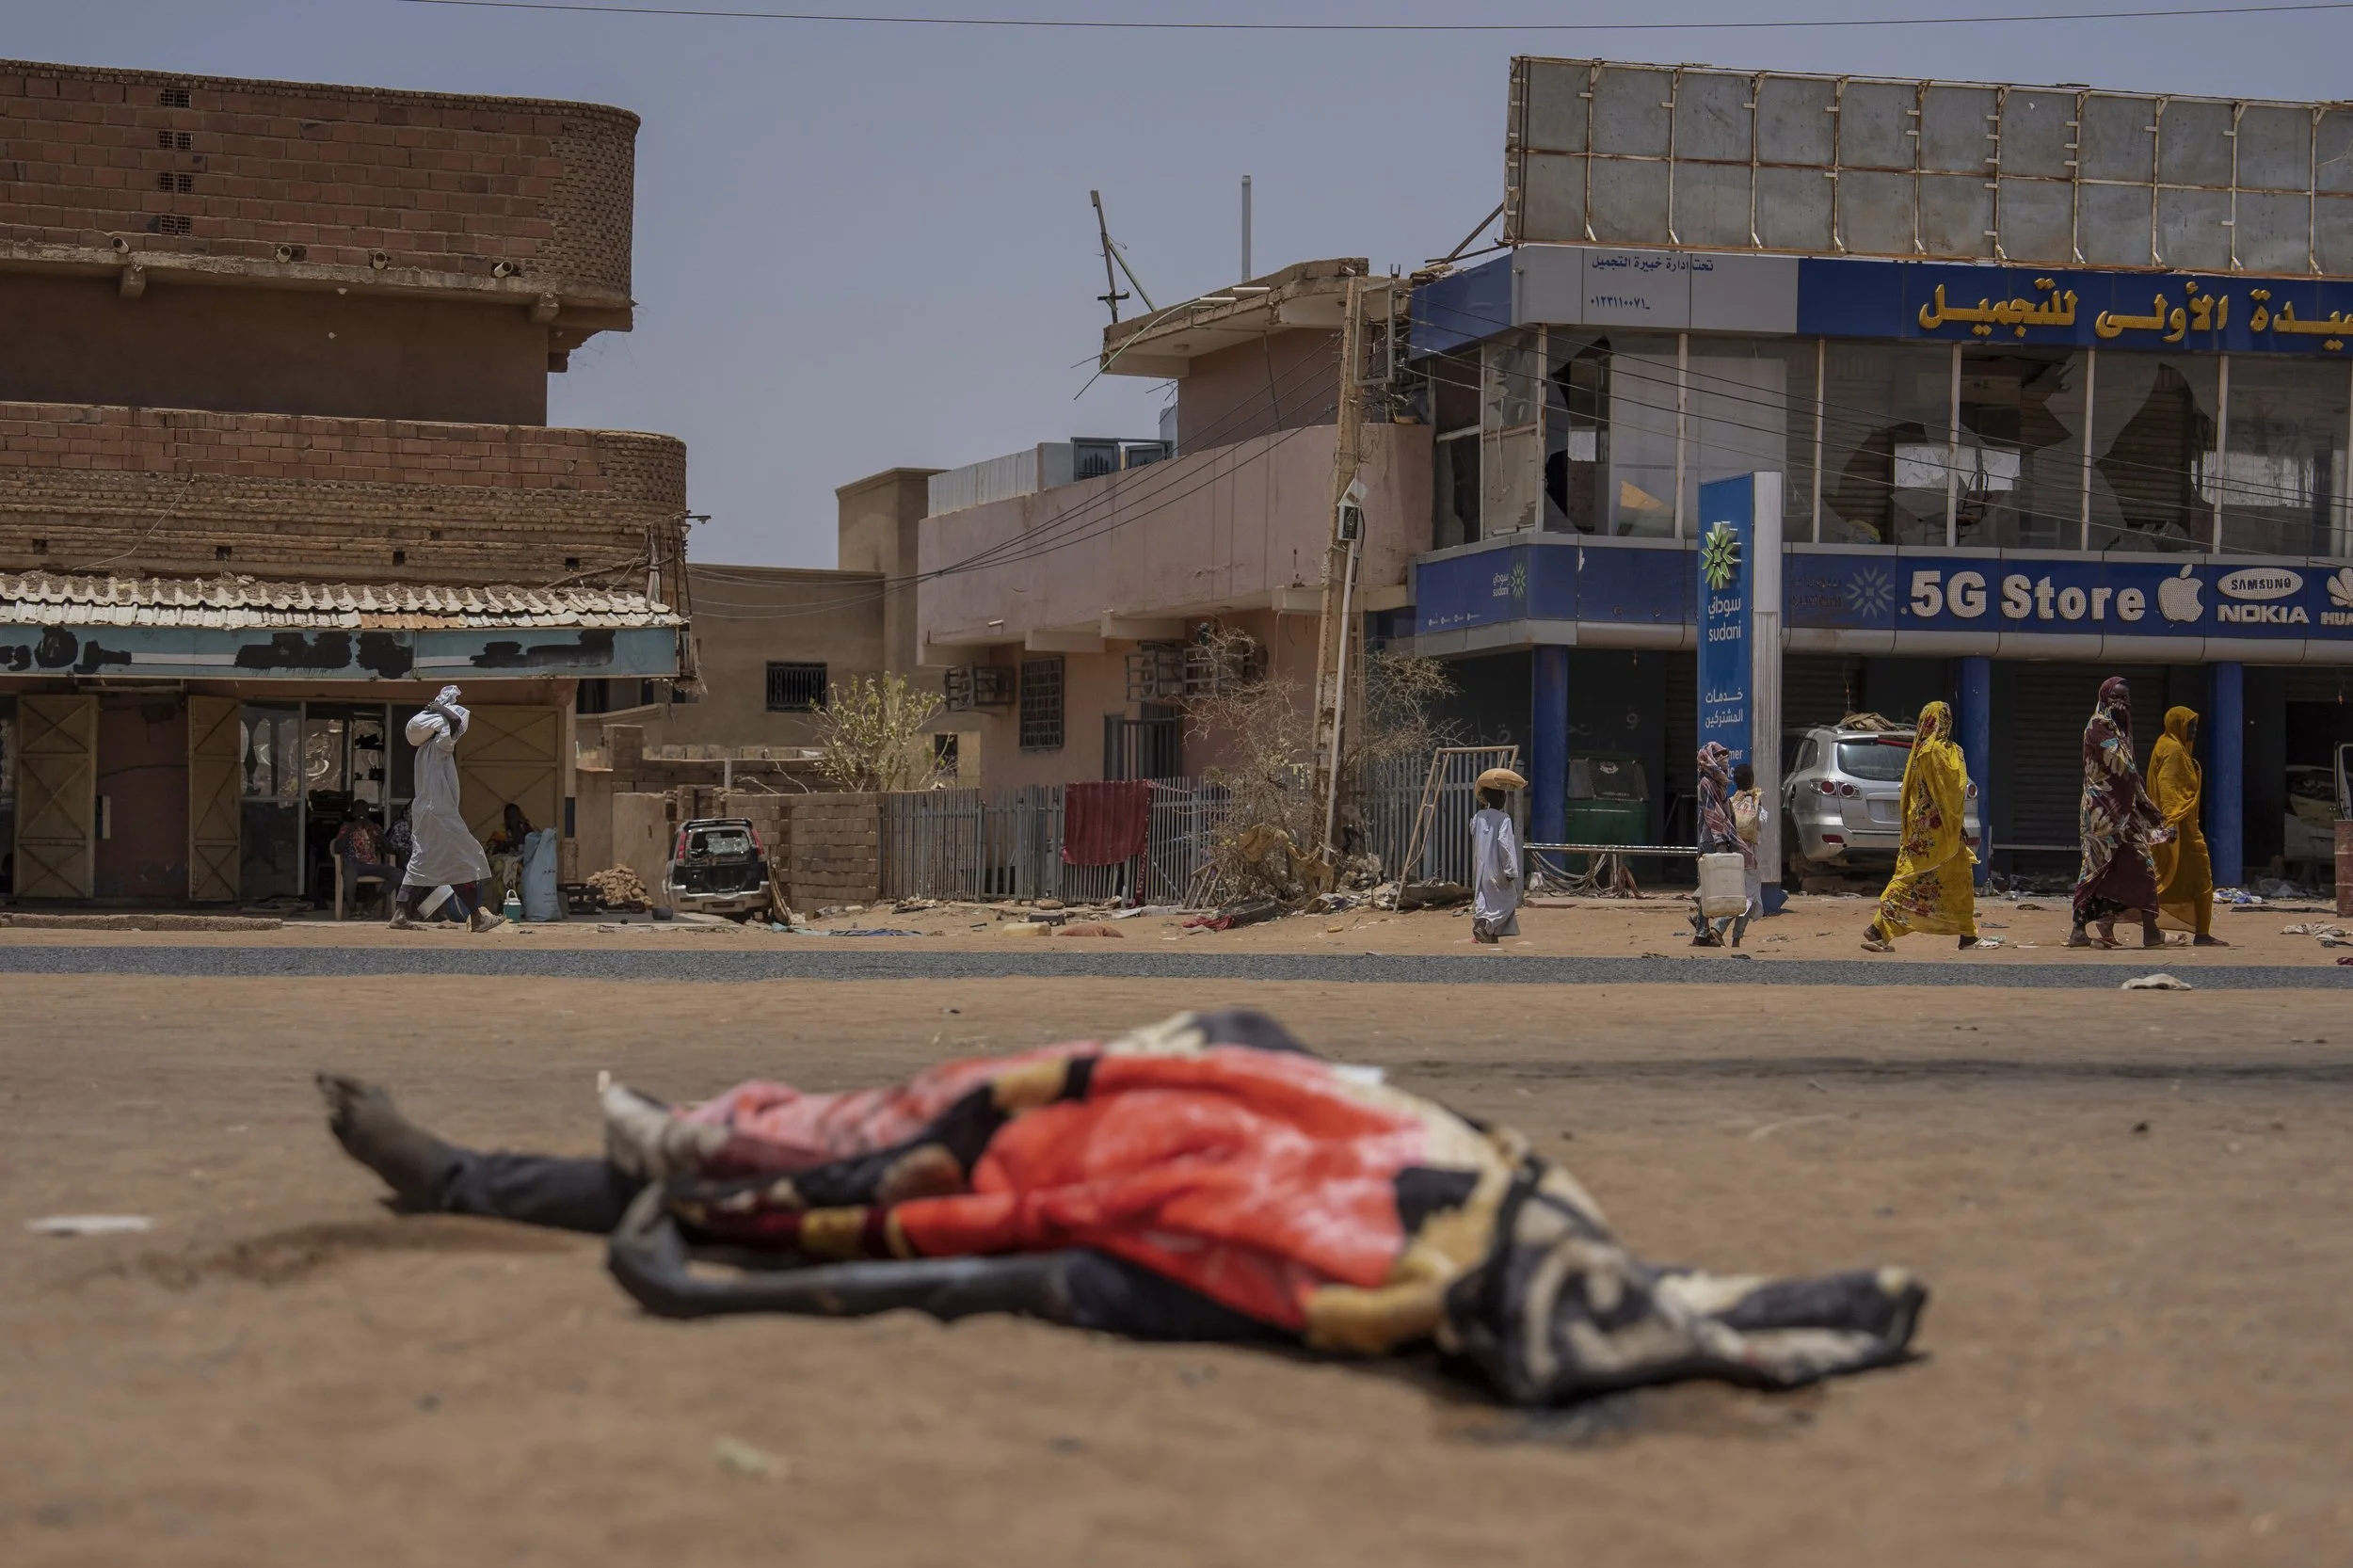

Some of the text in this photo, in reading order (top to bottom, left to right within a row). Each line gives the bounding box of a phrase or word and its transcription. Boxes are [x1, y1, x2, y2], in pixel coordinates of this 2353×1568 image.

[1592, 255, 1714, 274] تحت إدارة خبيرة التجميل
[1918, 278, 2078, 338] للتجميل
[2232, 578, 2292, 590] SAMSUNG
[1910, 570, 2146, 621] 5G Store
[1707, 597, 1741, 619] سوداني
[2217, 604, 2310, 624] NOKIA
[1708, 620, 1741, 642] sudani
[1705, 687, 1743, 704] خدمات
[1705, 708, 1743, 728] المشتركين
